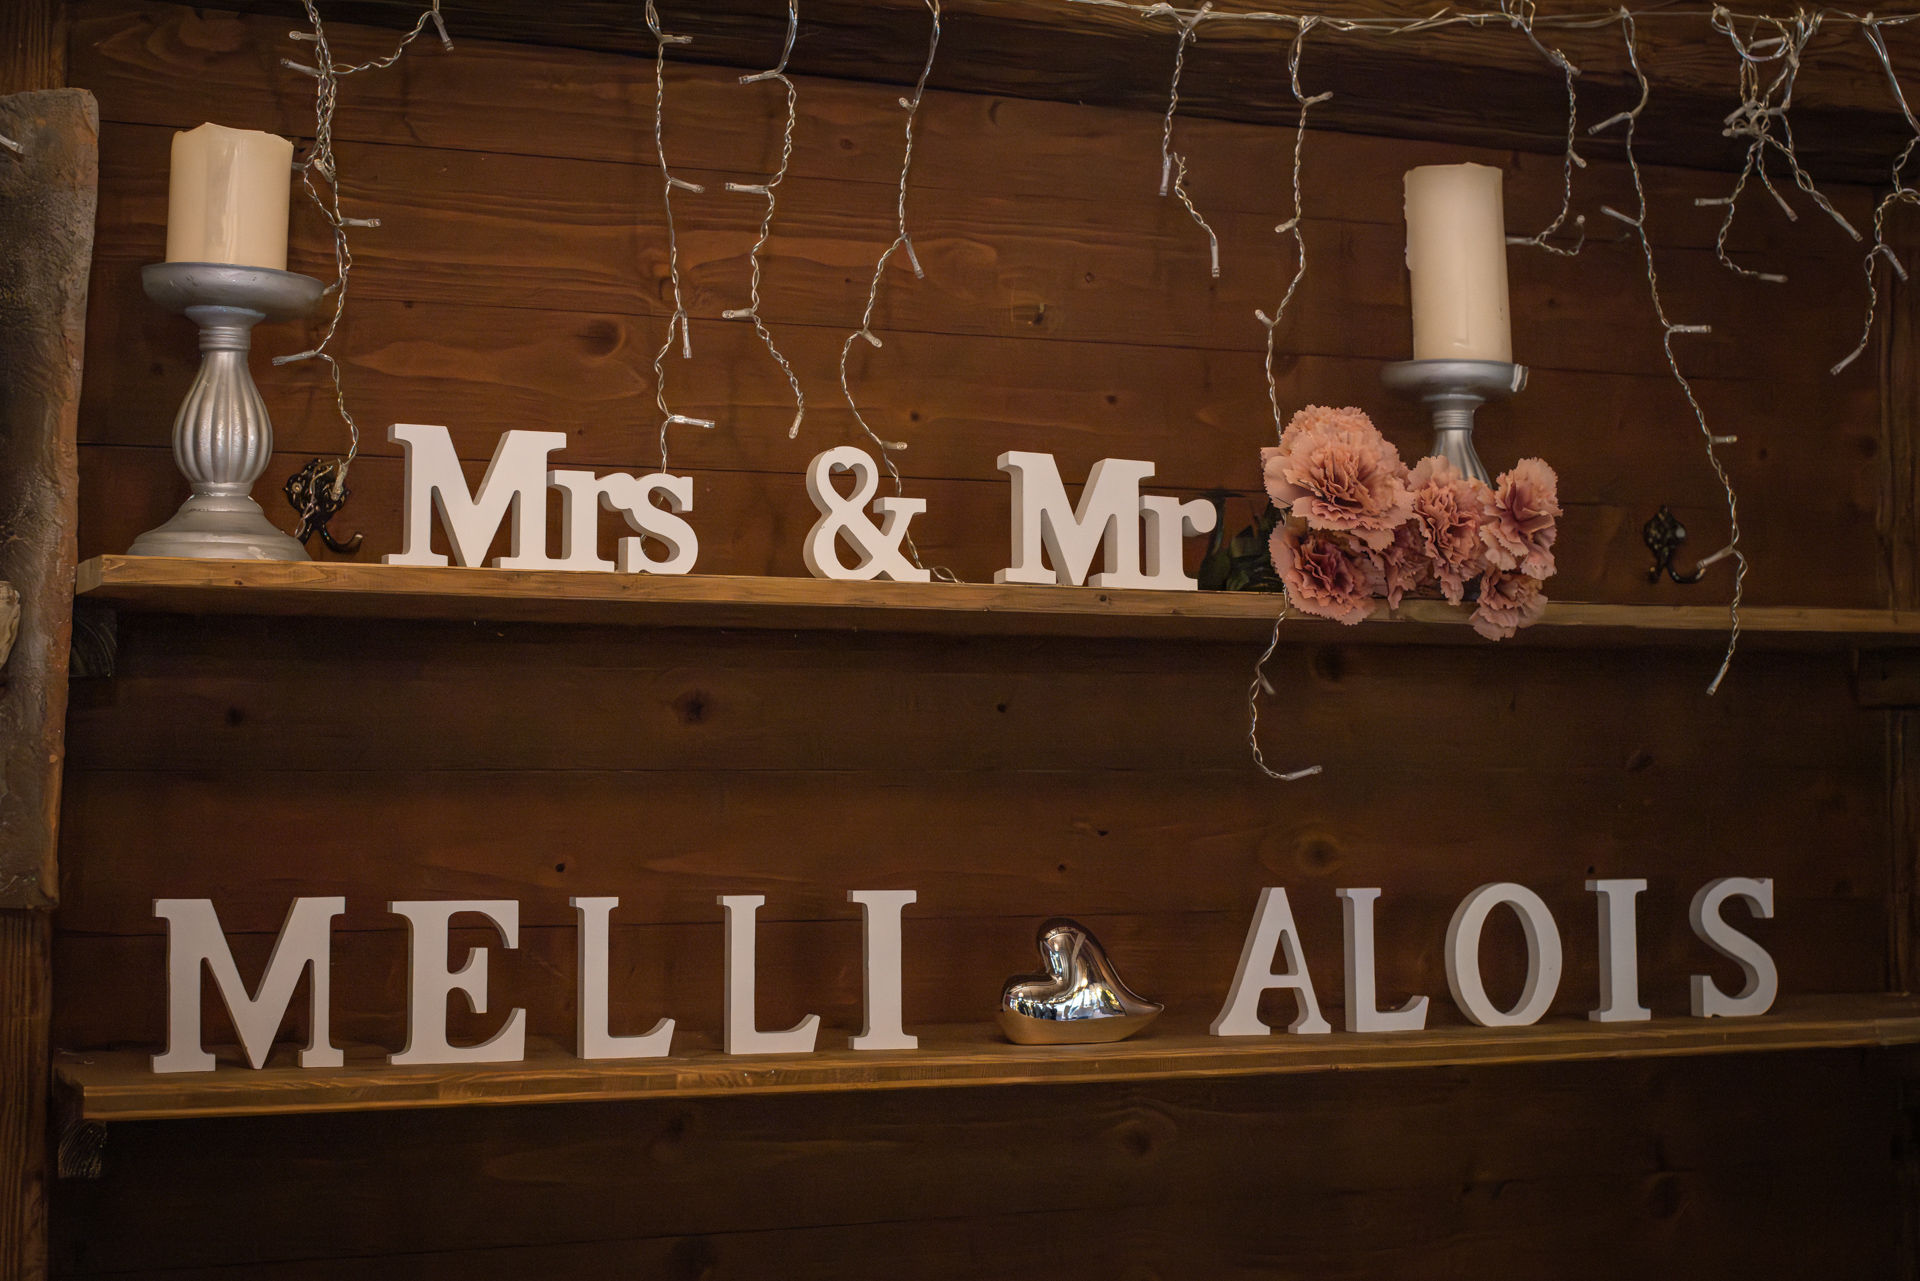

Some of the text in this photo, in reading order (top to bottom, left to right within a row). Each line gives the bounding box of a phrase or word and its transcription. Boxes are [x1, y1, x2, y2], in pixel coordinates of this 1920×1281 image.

[382, 423, 1217, 591] Mrs & Mr
[152, 877, 1777, 1074] MELLI ALOIS
